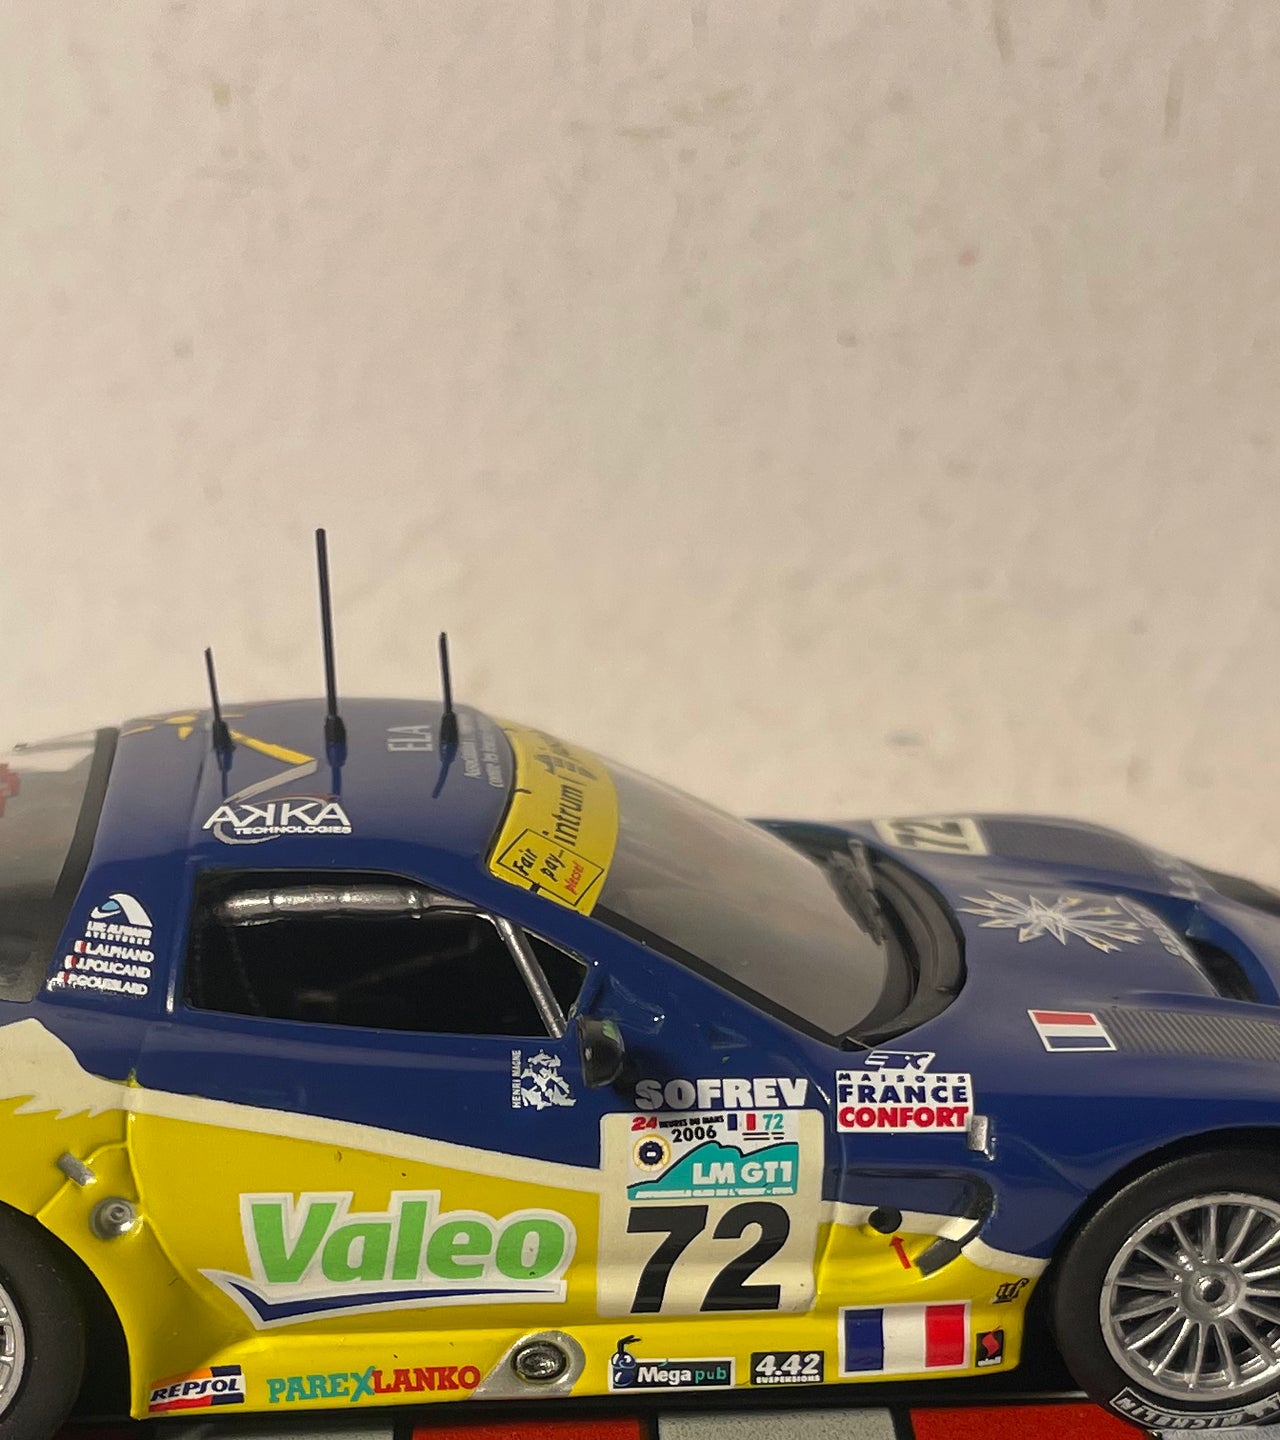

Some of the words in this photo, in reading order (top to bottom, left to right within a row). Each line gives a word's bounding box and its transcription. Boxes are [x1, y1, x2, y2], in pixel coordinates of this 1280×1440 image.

[386, 725, 433, 752] ELA
[202, 802, 352, 830] AKKA
[542, 783, 584, 847] intrum
[233, 825, 353, 836] TECHNOLOGIES
[512, 848, 539, 876] Fair
[837, 1072, 967, 1083] MAISONS
[634, 1078, 809, 1110] SOFREV
[837, 1084, 969, 1104] FRANCE
[631, 1116, 659, 1132] 24
[762, 1113, 785, 1131] 72
[838, 1106, 970, 1129] CONFORT
[671, 1125, 718, 1143] 2006
[692, 1161, 737, 1186] LM
[740, 1160, 794, 1184] GT1
[250, 1199, 567, 1284] Valeo
[626, 1201, 791, 1314] 72
[636, 1366, 692, 1387] Mega
[694, 1366, 727, 1385] pub
[754, 1352, 821, 1377] 4.42
[150, 1376, 242, 1403] REPSOL
[1115, 1396, 1245, 1429] MICHELIN
